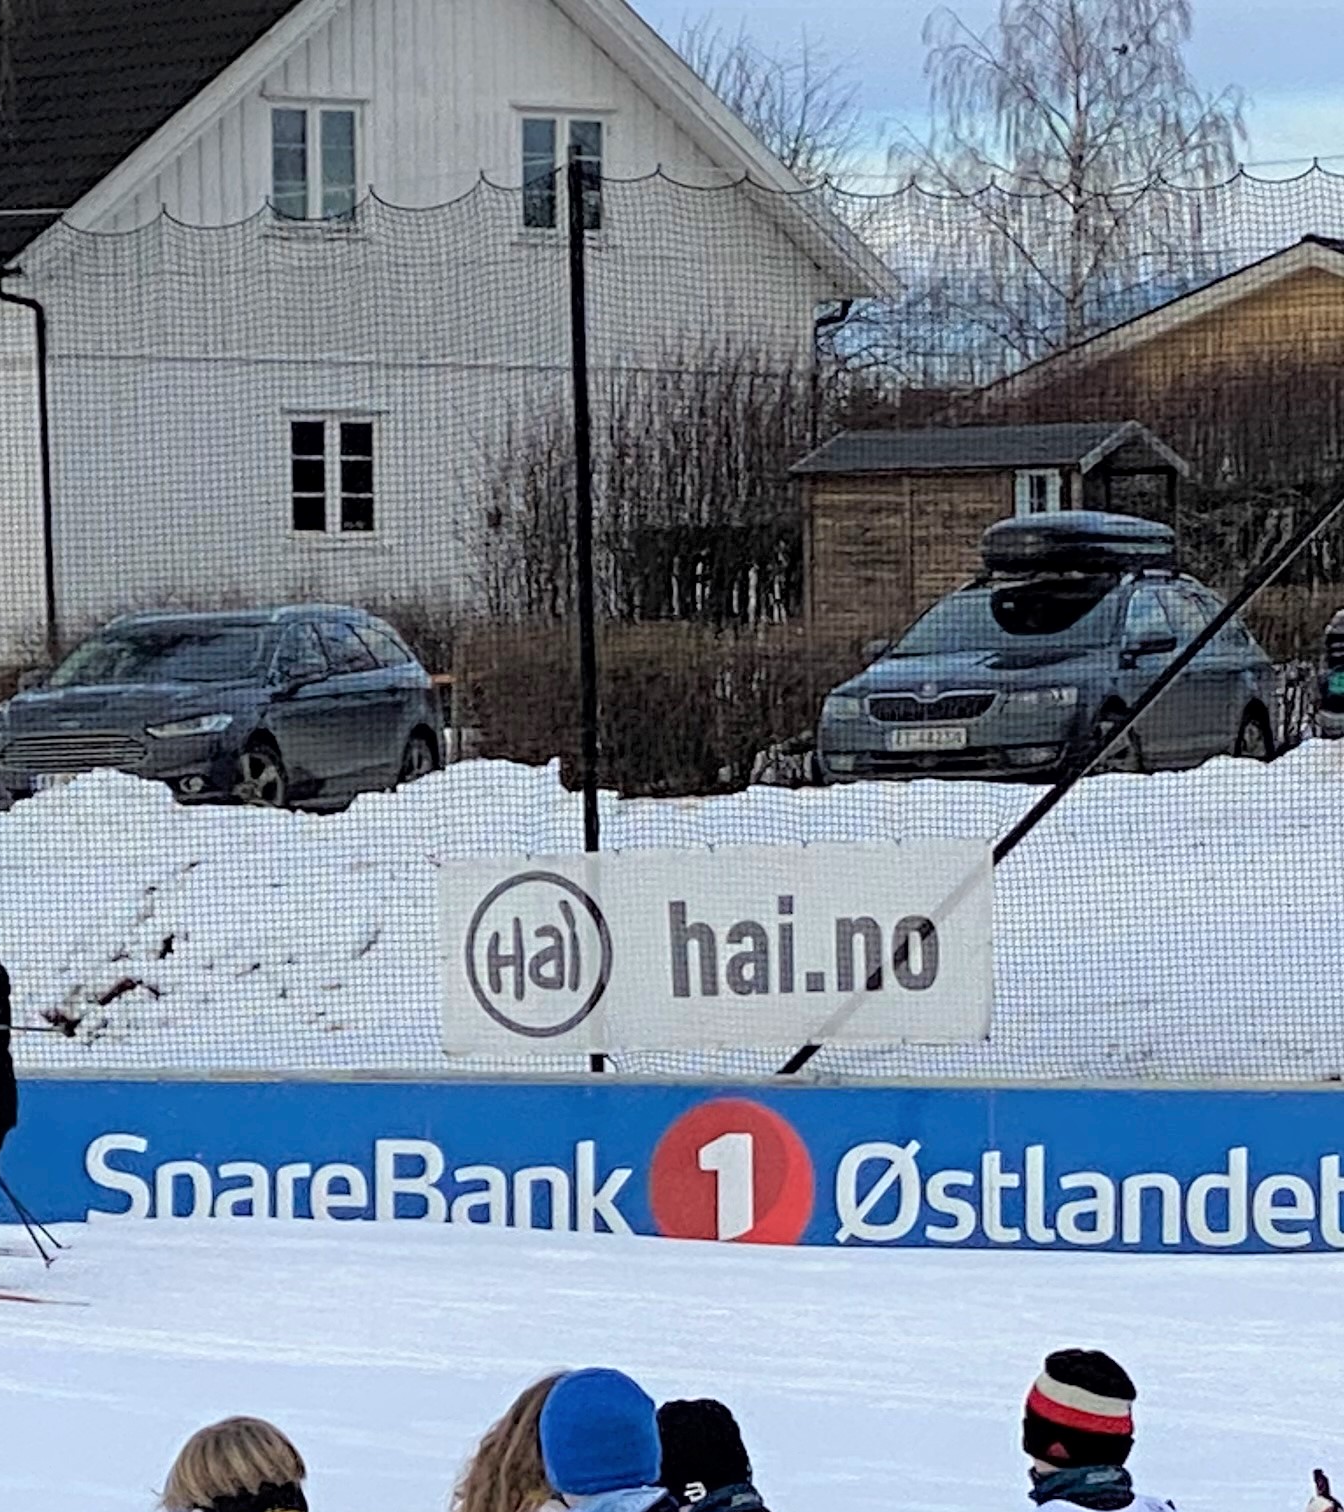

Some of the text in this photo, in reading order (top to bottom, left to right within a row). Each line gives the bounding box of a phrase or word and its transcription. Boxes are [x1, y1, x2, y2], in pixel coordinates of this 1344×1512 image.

[668, 894, 940, 998] hai.no
[85, 1132, 634, 1236] SpareBank
[697, 1131, 754, 1242] 1
